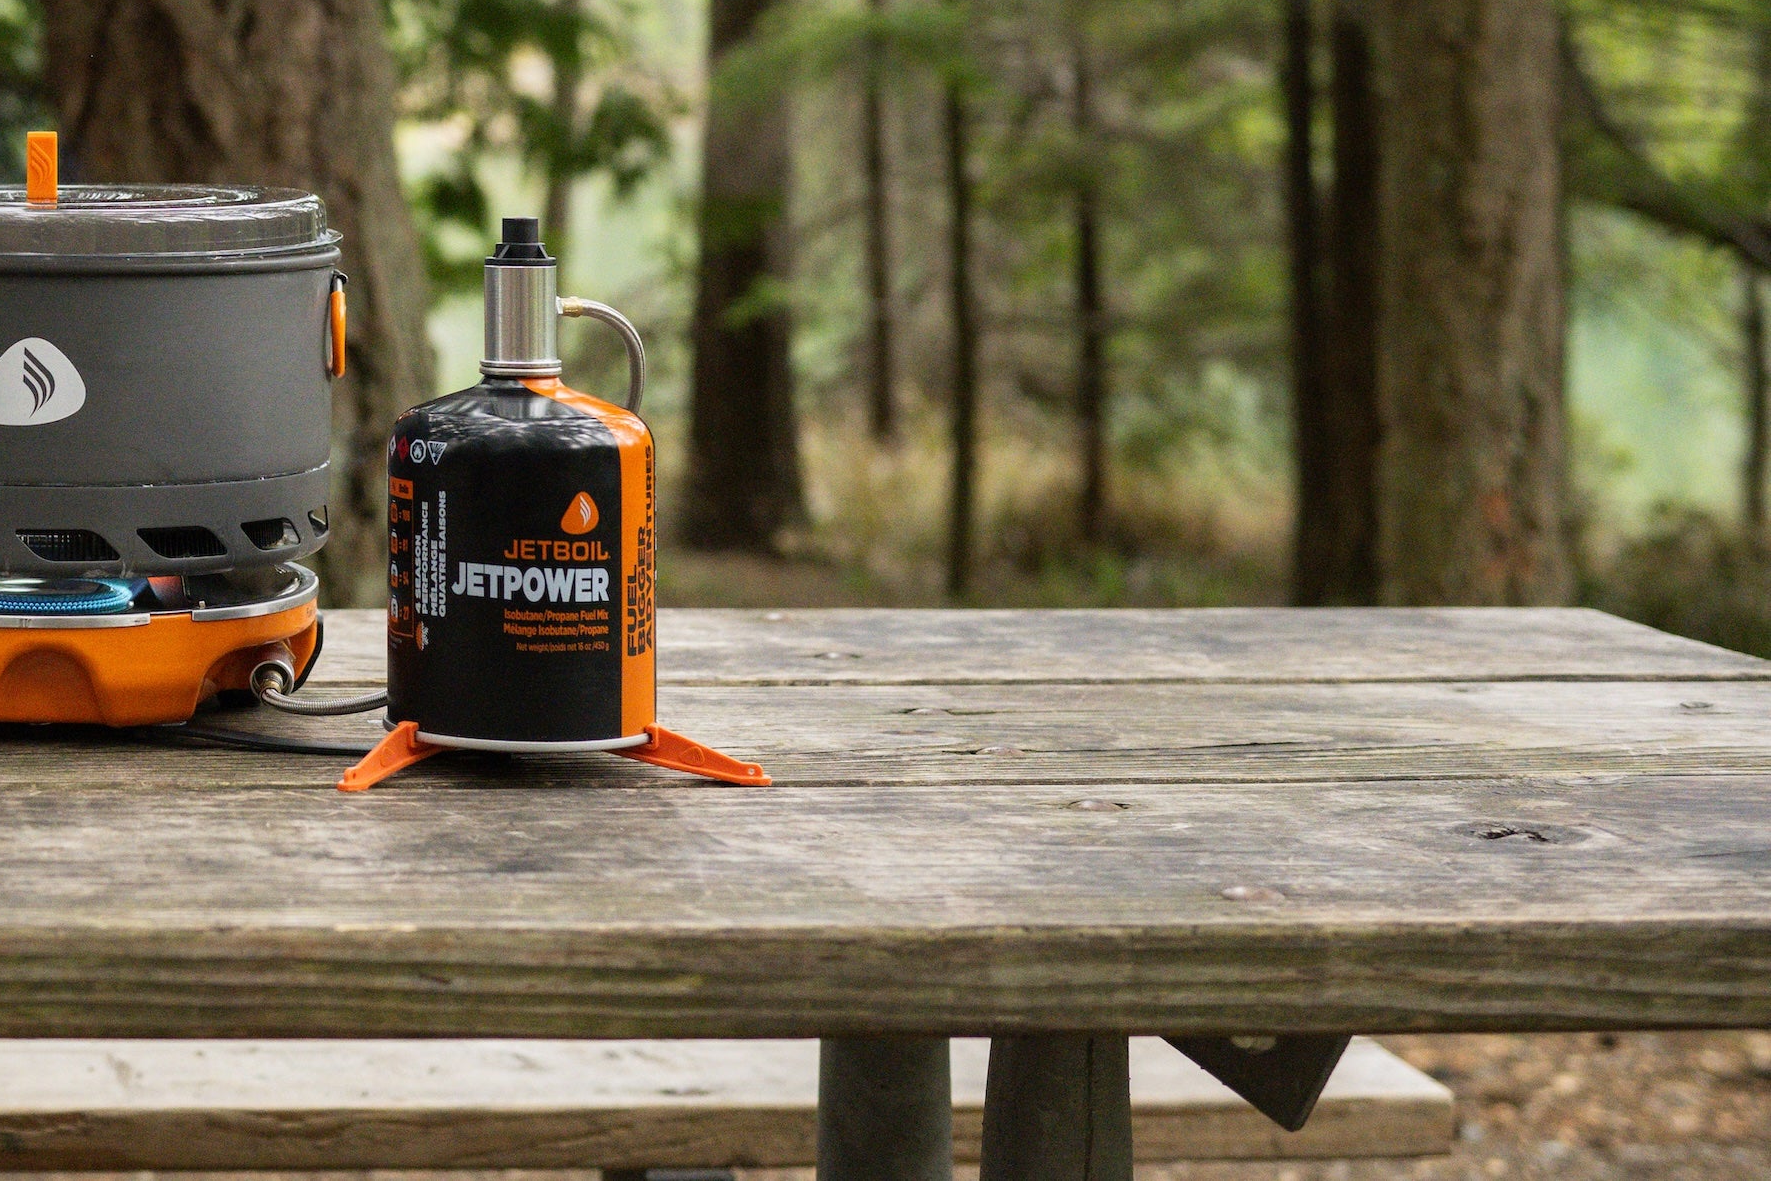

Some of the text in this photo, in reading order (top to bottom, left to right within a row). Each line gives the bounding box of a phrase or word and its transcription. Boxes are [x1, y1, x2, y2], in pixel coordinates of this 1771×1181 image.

[421, 501, 429, 615] PERFORMANCE
[429, 539, 438, 616] MÉLANGE
[438, 490, 447, 617] QUATRE SAISONS
[451, 562, 609, 602] JETPOWER
[504, 539, 609, 561] JETBOIL
[645, 445, 653, 650] ADVENTURES
[415, 601, 422, 614] 4
[580, 610, 596, 621] Fuel
[597, 610, 608, 620] Mix
[626, 564, 637, 657] FUEL
[637, 526, 646, 656] BIGGER
